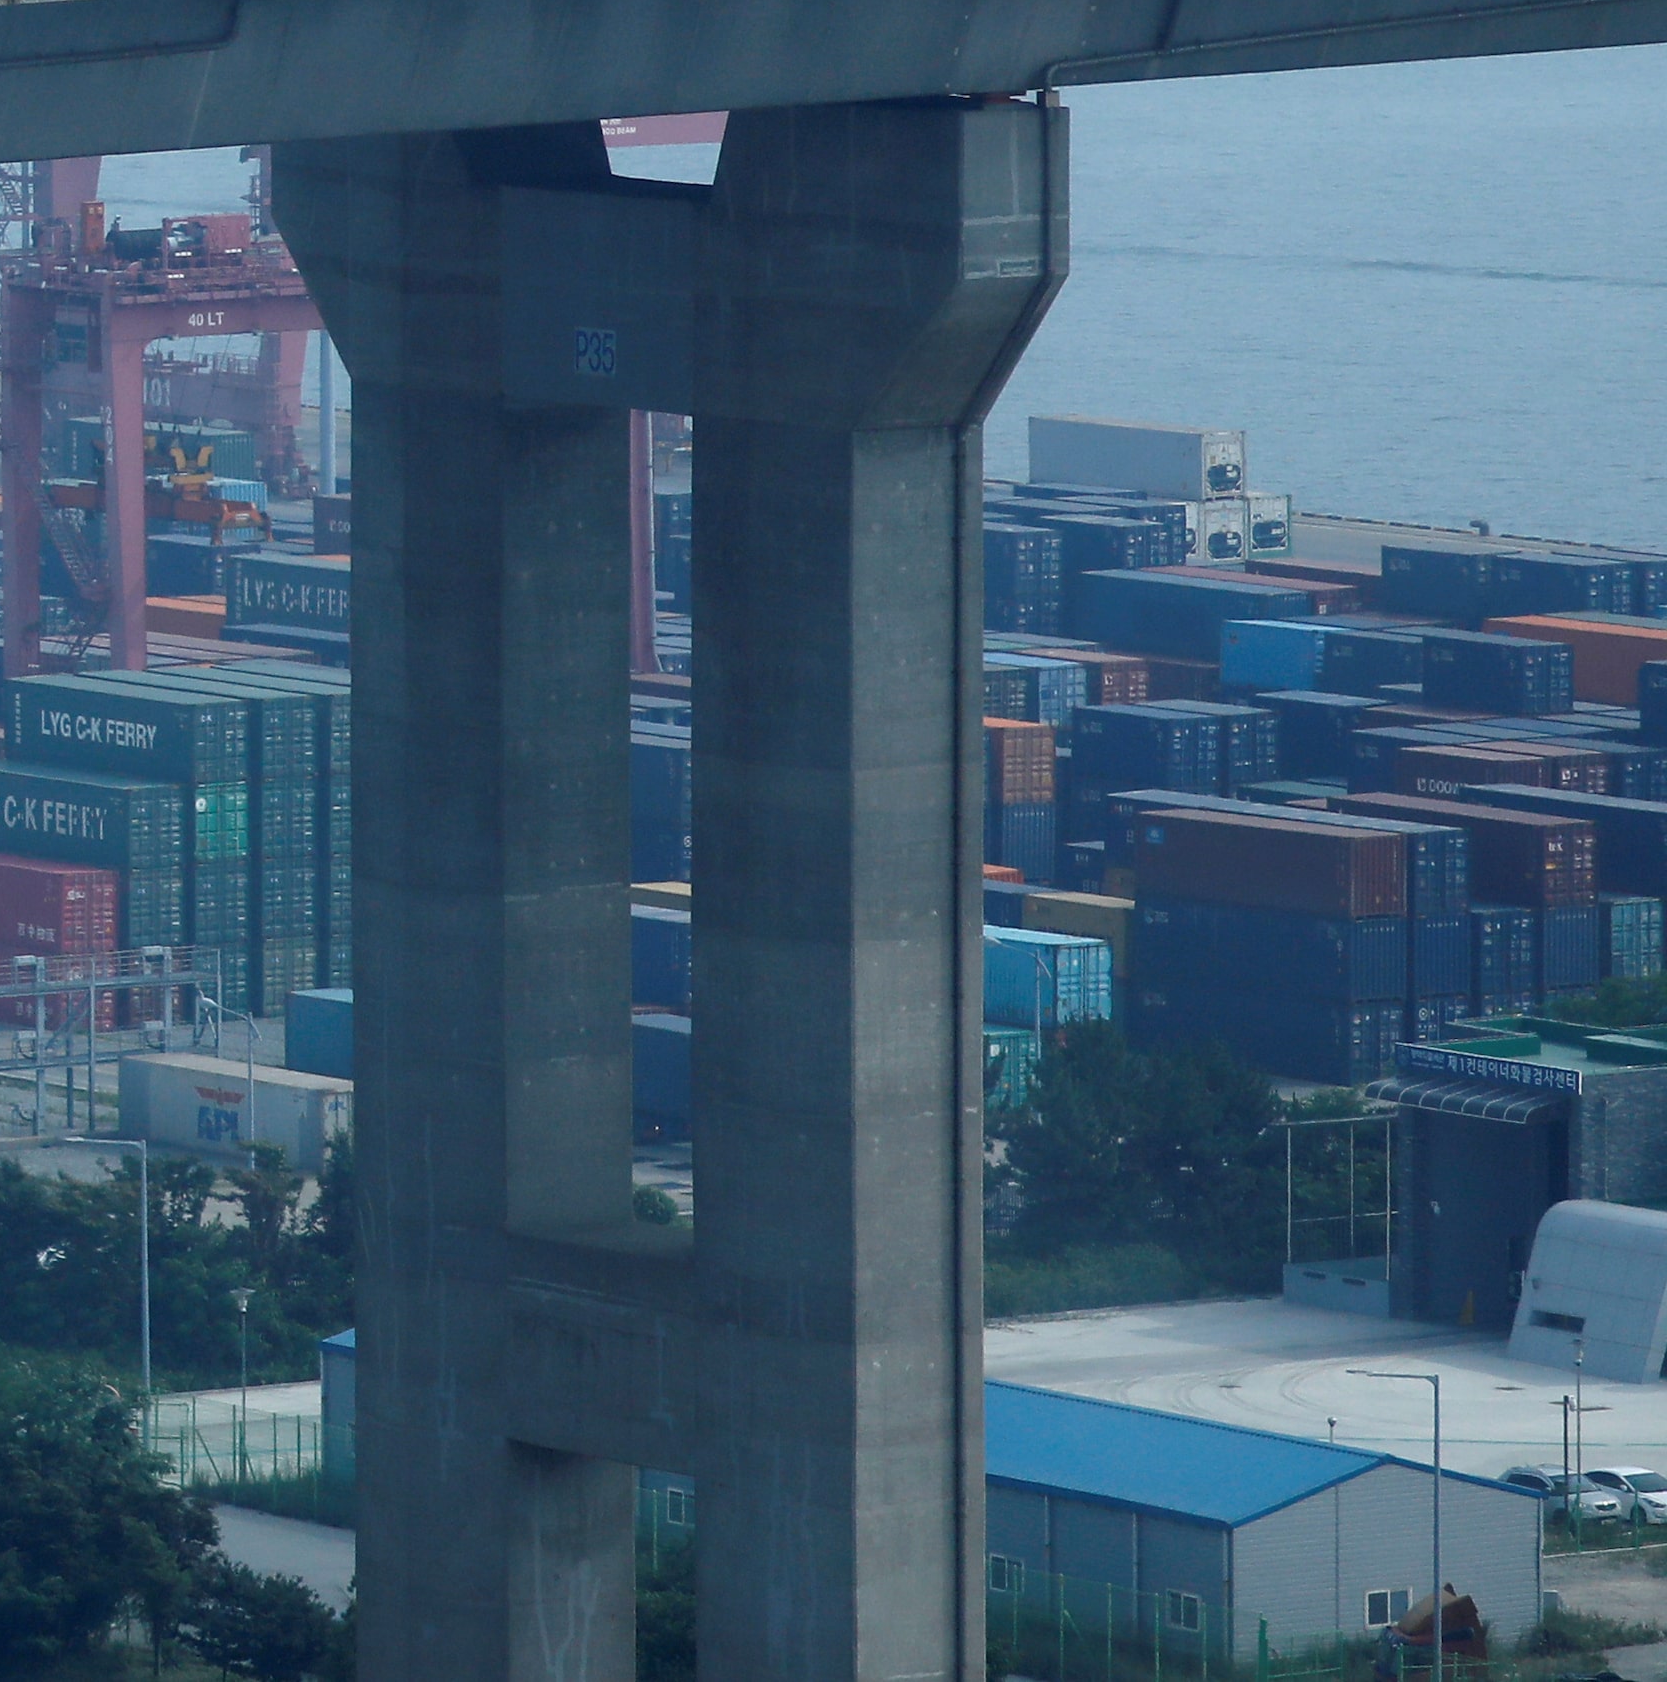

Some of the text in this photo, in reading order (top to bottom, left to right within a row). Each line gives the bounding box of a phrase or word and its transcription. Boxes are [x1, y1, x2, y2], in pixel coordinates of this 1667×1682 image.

[187, 311, 225, 327] 40 LT
[575, 330, 615, 372] P35
[41, 709, 72, 738] LYG
[75, 714, 102, 743] C-K
[105, 718, 157, 750] FERRY
[3, 795, 37, 831] C-K
